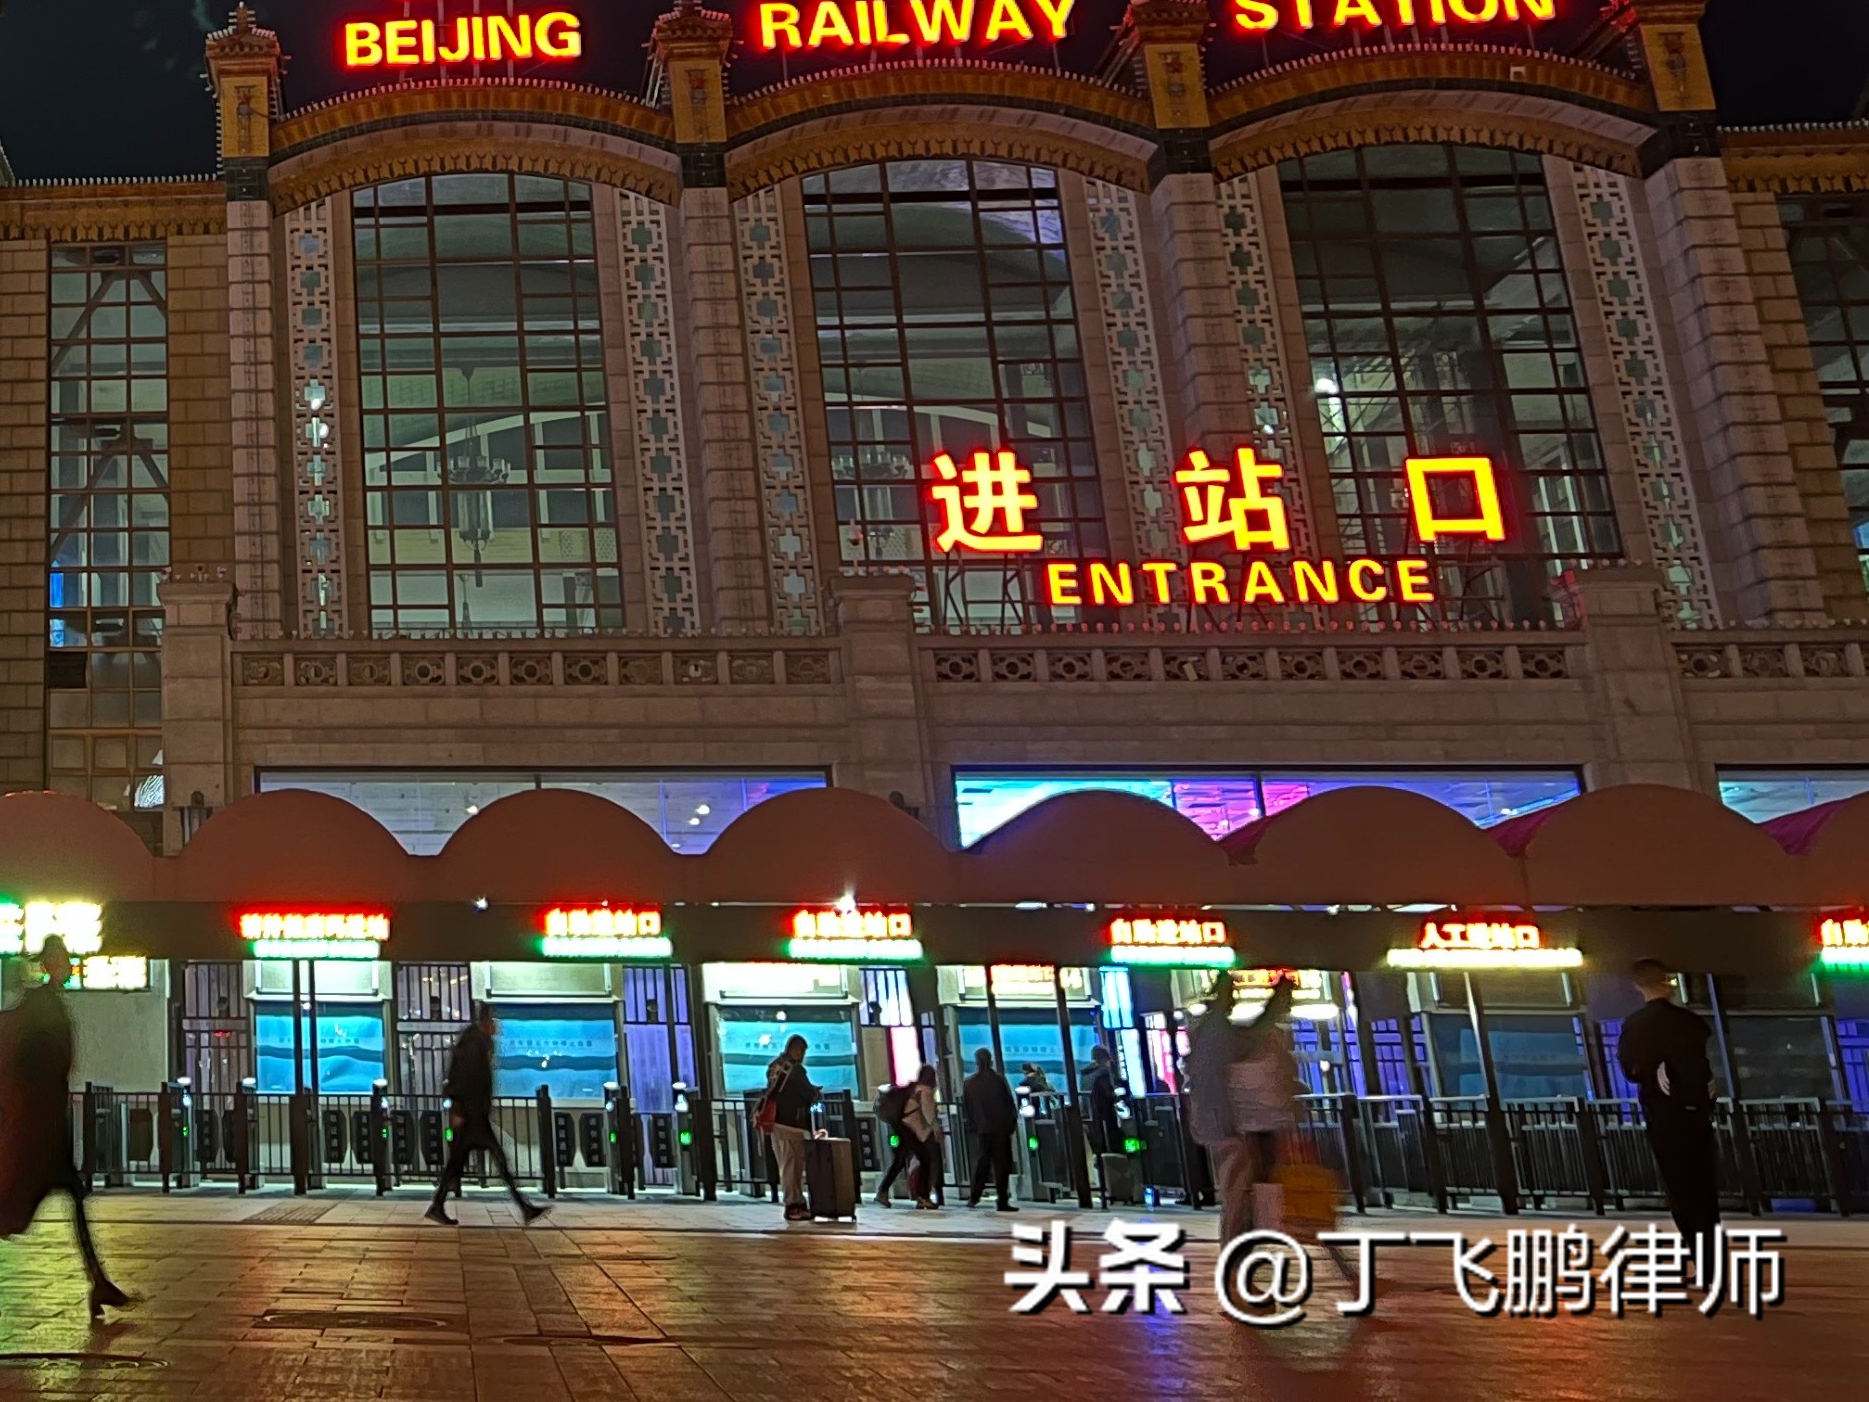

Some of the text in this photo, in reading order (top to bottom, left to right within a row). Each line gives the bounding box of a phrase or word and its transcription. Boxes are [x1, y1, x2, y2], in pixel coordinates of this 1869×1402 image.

[345, 11, 582, 66] BEIJING
[931, 447, 1506, 553] 进站口
[1047, 558, 1434, 605] ENTRANCE
